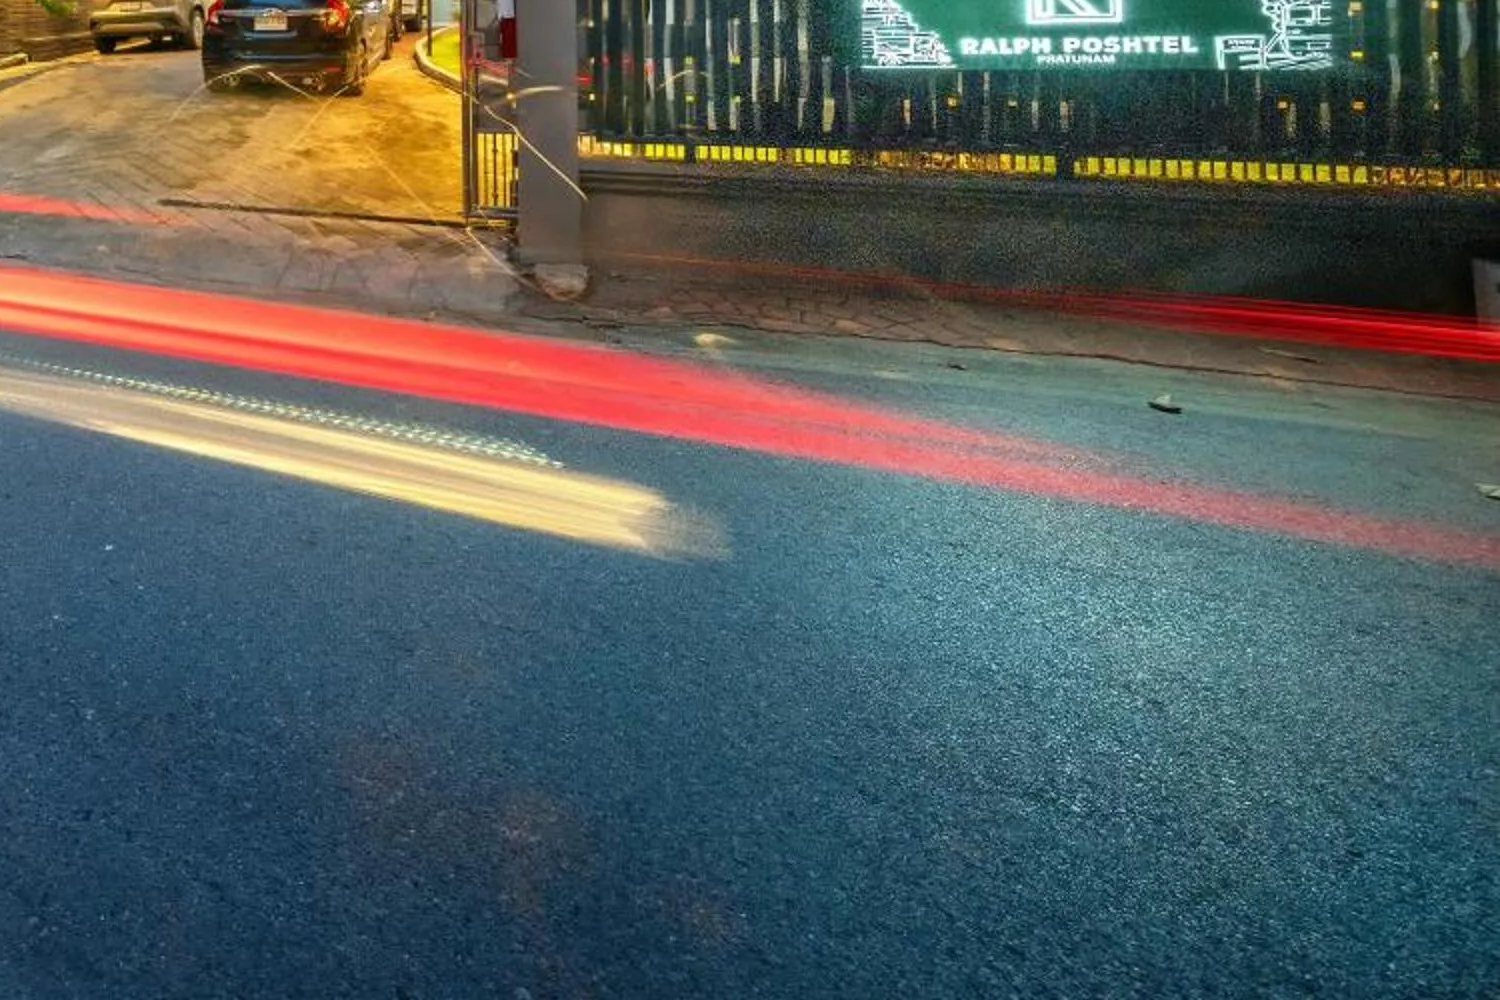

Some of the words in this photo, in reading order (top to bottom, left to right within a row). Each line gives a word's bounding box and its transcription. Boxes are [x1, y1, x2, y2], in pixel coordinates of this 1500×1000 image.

[960, 36, 1051, 55] RALPH
[1062, 35, 1199, 54] POSHTEL
[1036, 54, 1116, 65] PRATUNAM
